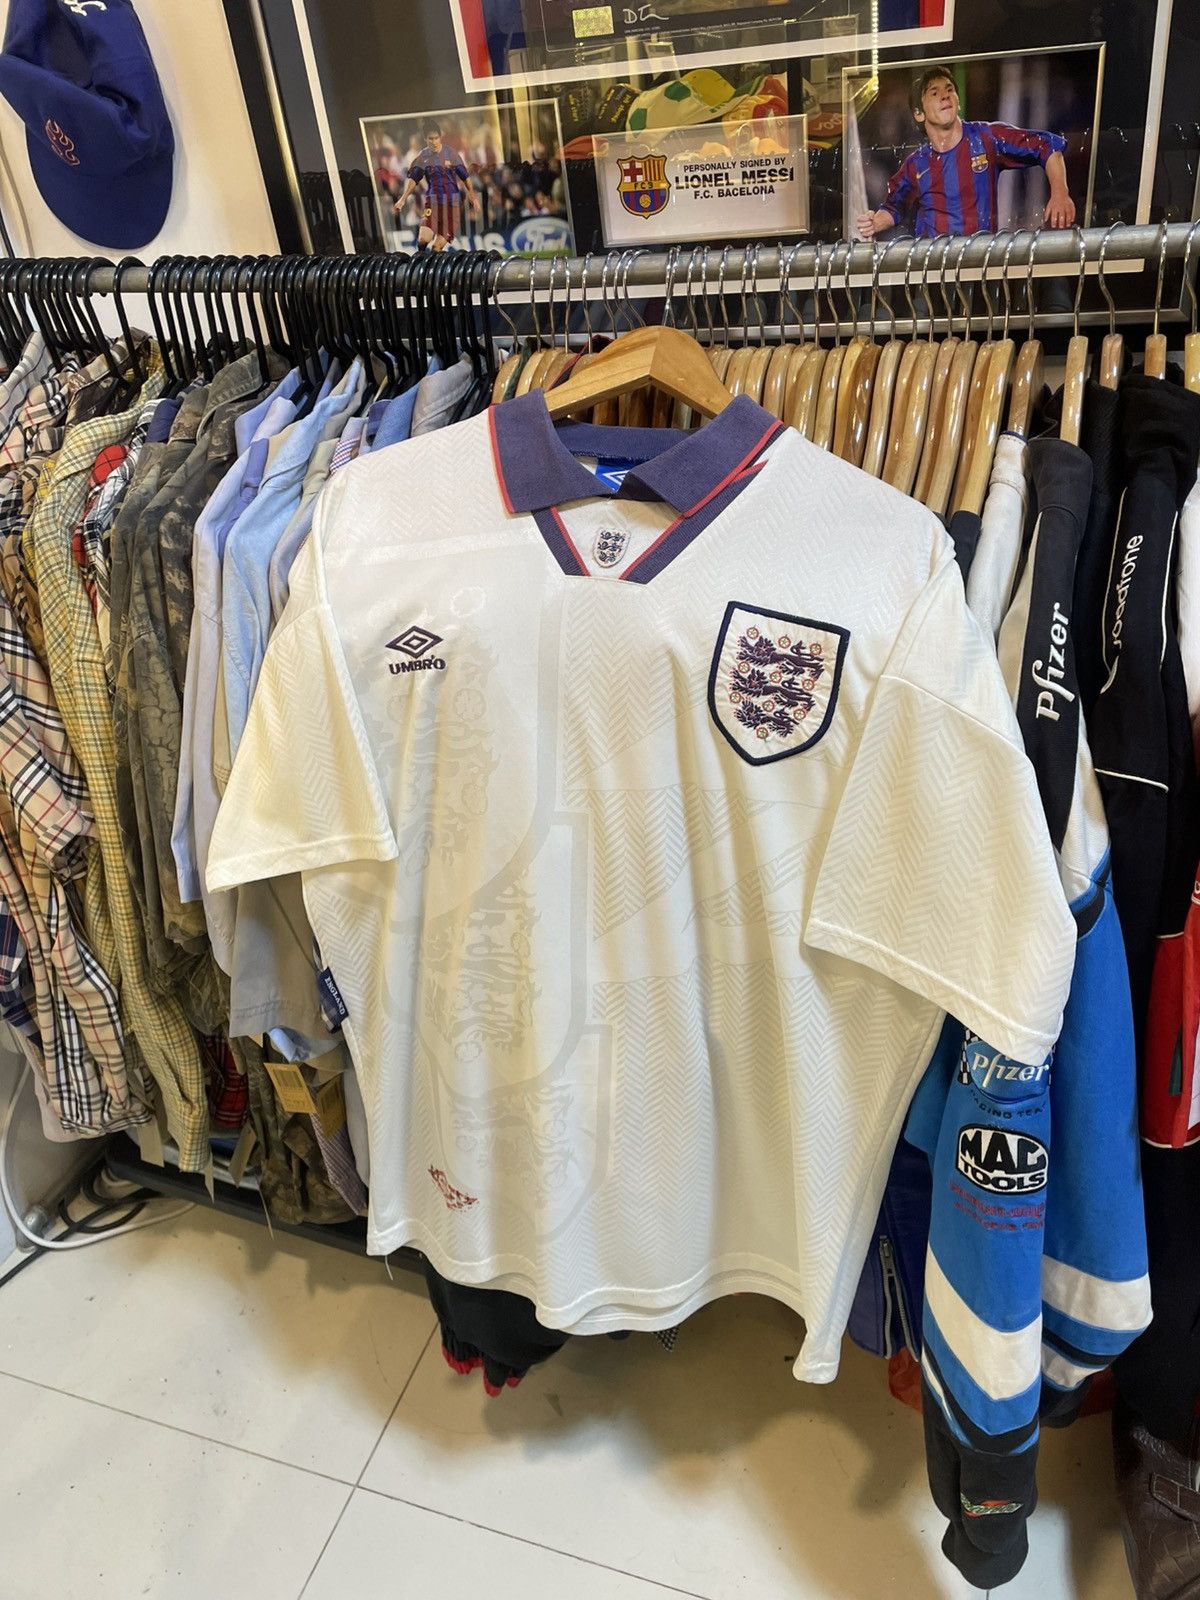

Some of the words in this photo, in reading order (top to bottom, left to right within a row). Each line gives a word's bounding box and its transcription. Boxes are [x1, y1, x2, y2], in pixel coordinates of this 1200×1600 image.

[675, 172, 734, 190] LIONEL
[741, 166, 794, 185] MESSI
[683, 161, 737, 173] PERSONALLY
[739, 158, 771, 168] SIGNED
[774, 157, 786, 165] BY
[693, 190, 714, 199] F.C.
[717, 184, 775, 198] BACELONA
[388, 657, 447, 675] UMBRO
[1031, 601, 1075, 722] Pfizer
[324, 976, 345, 1015] ENGLAND
[972, 1050, 1050, 1089] Pfizer
[959, 1130, 1048, 1174] MAC
[958, 1161, 1046, 1191] TOOLS
